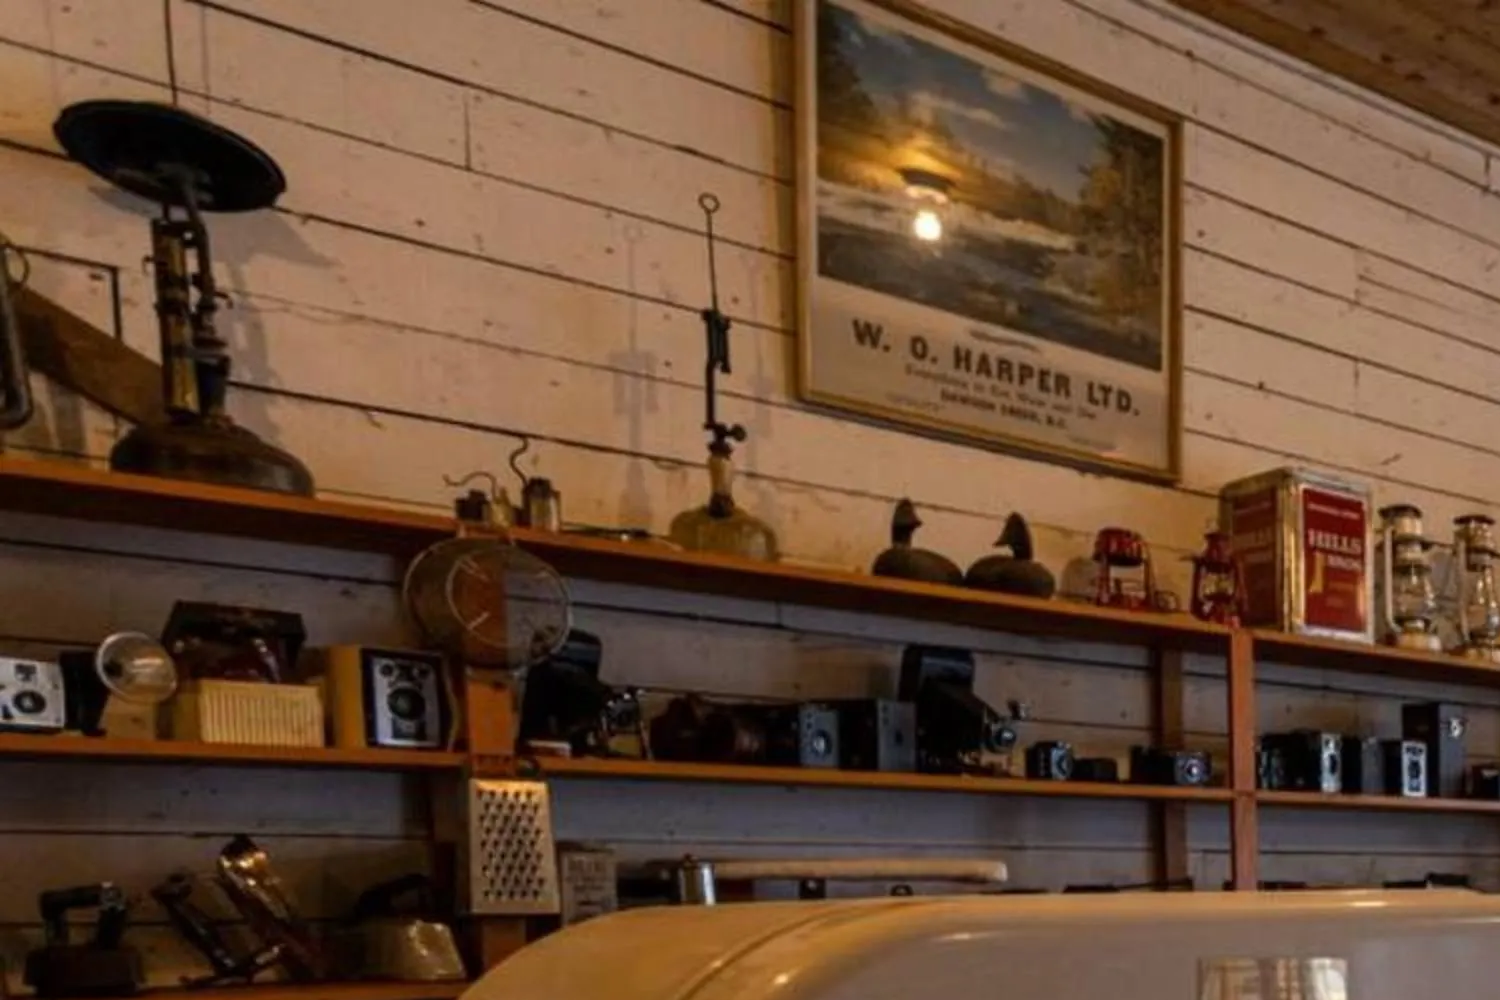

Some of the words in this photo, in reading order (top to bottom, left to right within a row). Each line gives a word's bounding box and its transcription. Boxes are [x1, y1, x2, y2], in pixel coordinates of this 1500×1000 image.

[852, 318, 891, 353] W.
[910, 335, 939, 364] O.
[953, 344, 1072, 400] HARPER
[1087, 380, 1141, 417] LTD.
